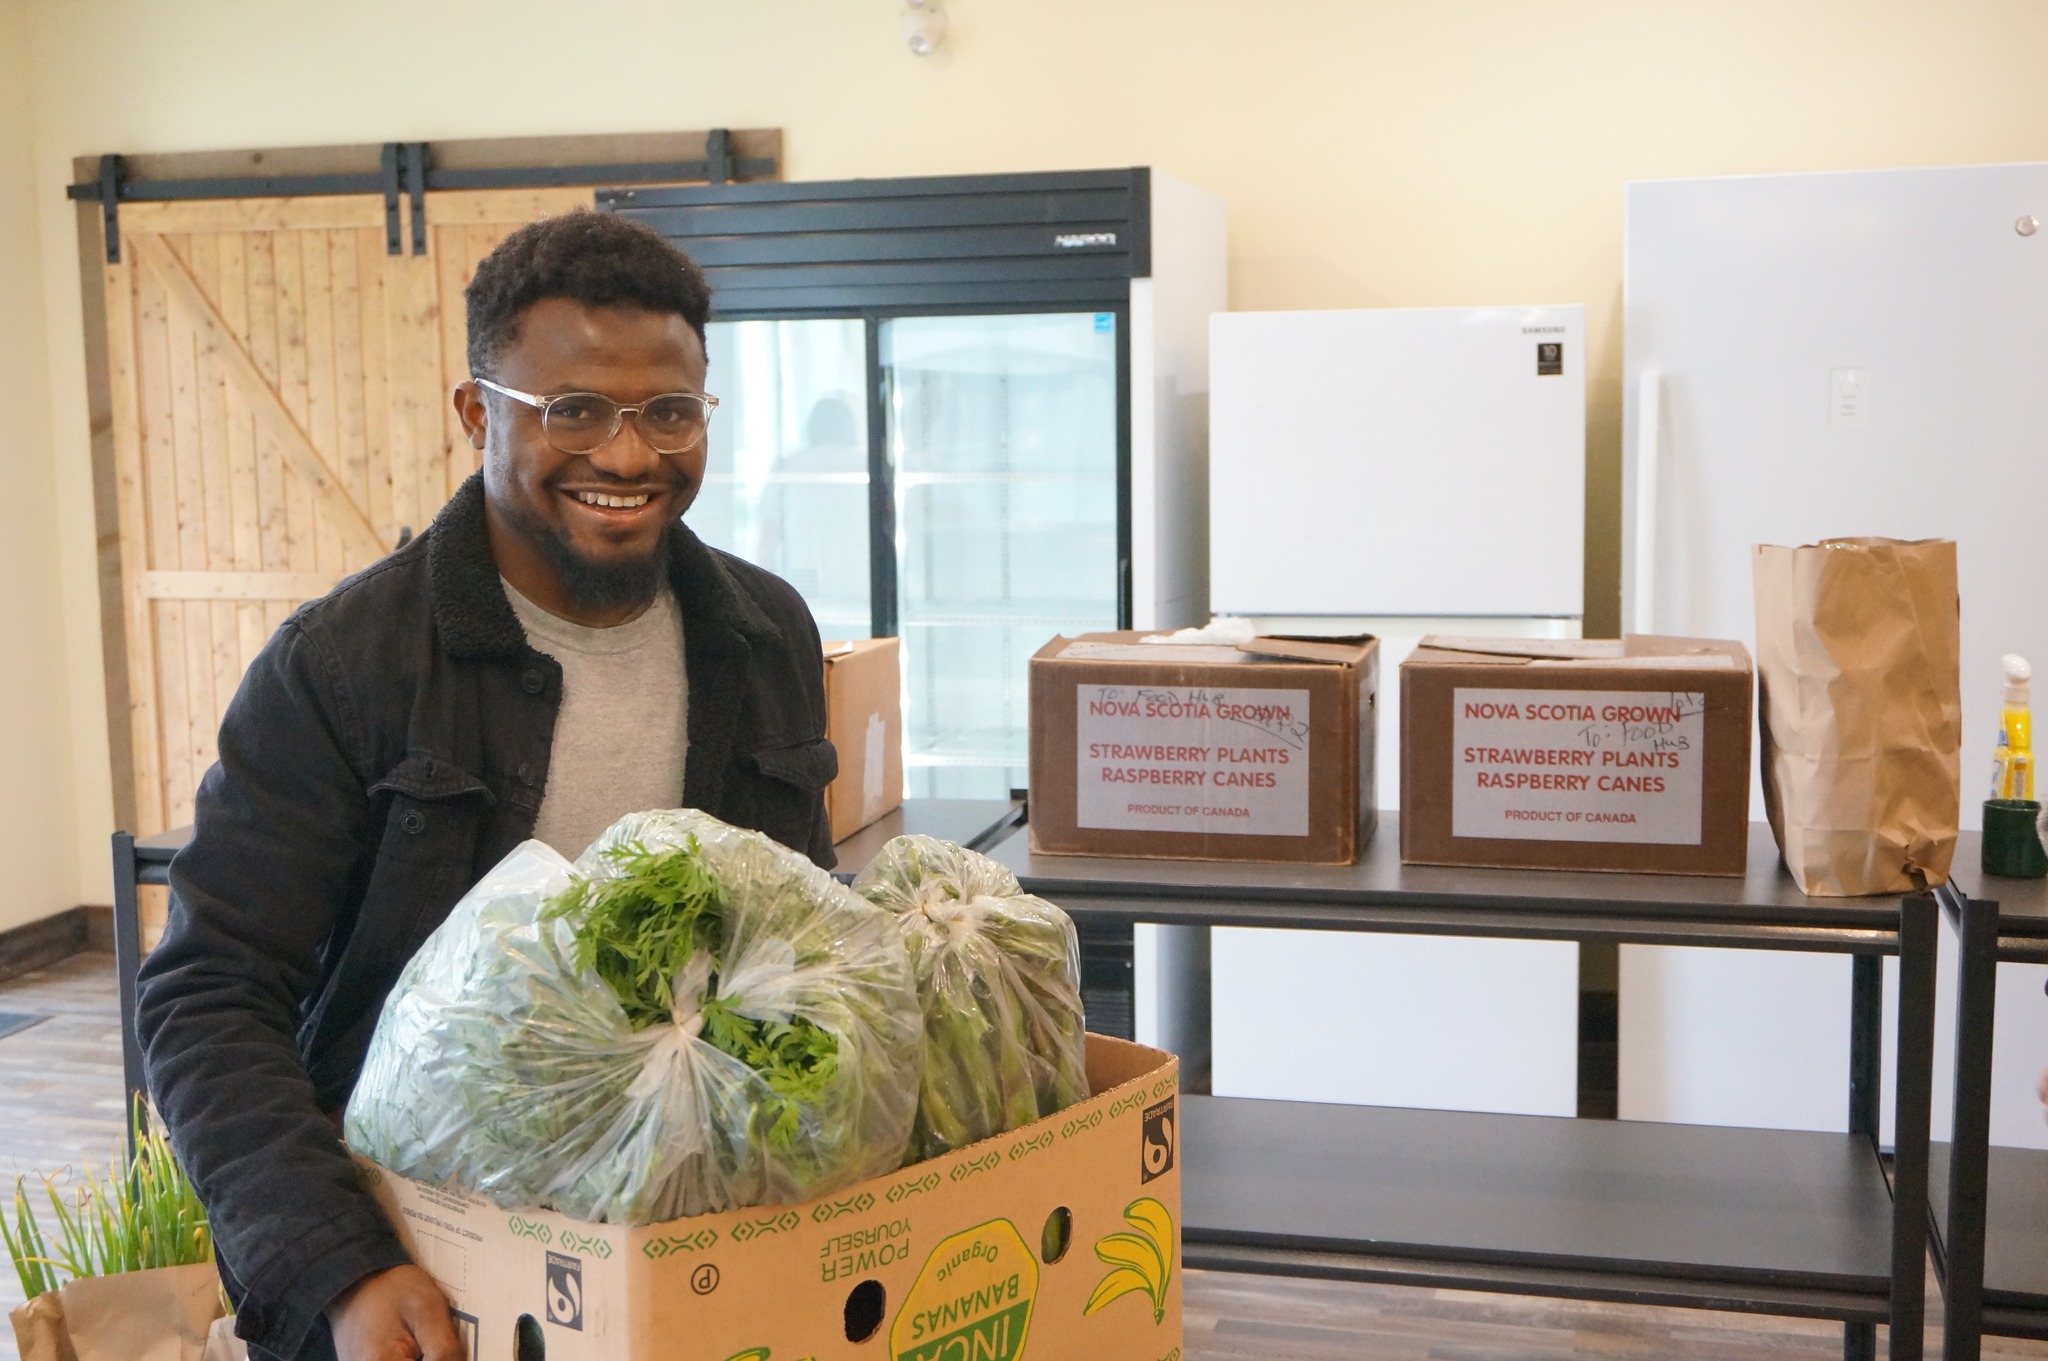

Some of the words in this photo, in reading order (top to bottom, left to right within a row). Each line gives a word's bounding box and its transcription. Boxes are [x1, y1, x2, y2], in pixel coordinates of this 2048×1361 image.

[1089, 701, 1141, 717] NOVA
[1146, 702, 1211, 719] SCOTIA
[1216, 704, 1291, 720] GROWN
[1464, 703, 1521, 720] NOVA
[1525, 704, 1596, 721] SCOTIA
[1601, 705, 1682, 723] GROWN
[1089, 743, 1211, 763] STRAWBERRY
[1217, 747, 1291, 765] PLANTS
[1464, 747, 1596, 768] STRAWBERRY
[1602, 751, 1680, 769] PLANTS
[1102, 767, 1207, 786] RASPBERRY
[1213, 770, 1277, 788] CANES
[1477, 771, 1590, 791] RASPBERRY
[1597, 775, 1666, 793] CANES
[1127, 803, 1181, 816] PRODUCT
[1184, 806, 1200, 816] OF
[1202, 806, 1251, 818] CANADA
[1504, 809, 1563, 822] PRODUCT
[1566, 811, 1582, 823] OF
[1585, 812, 1637, 825] CANADA
[820, 1217, 912, 1258] YOURSELF
[822, 1238, 910, 1282] POWER
[937, 1240, 998, 1282] Organic
[912, 1273, 1019, 1339] BANANAS
